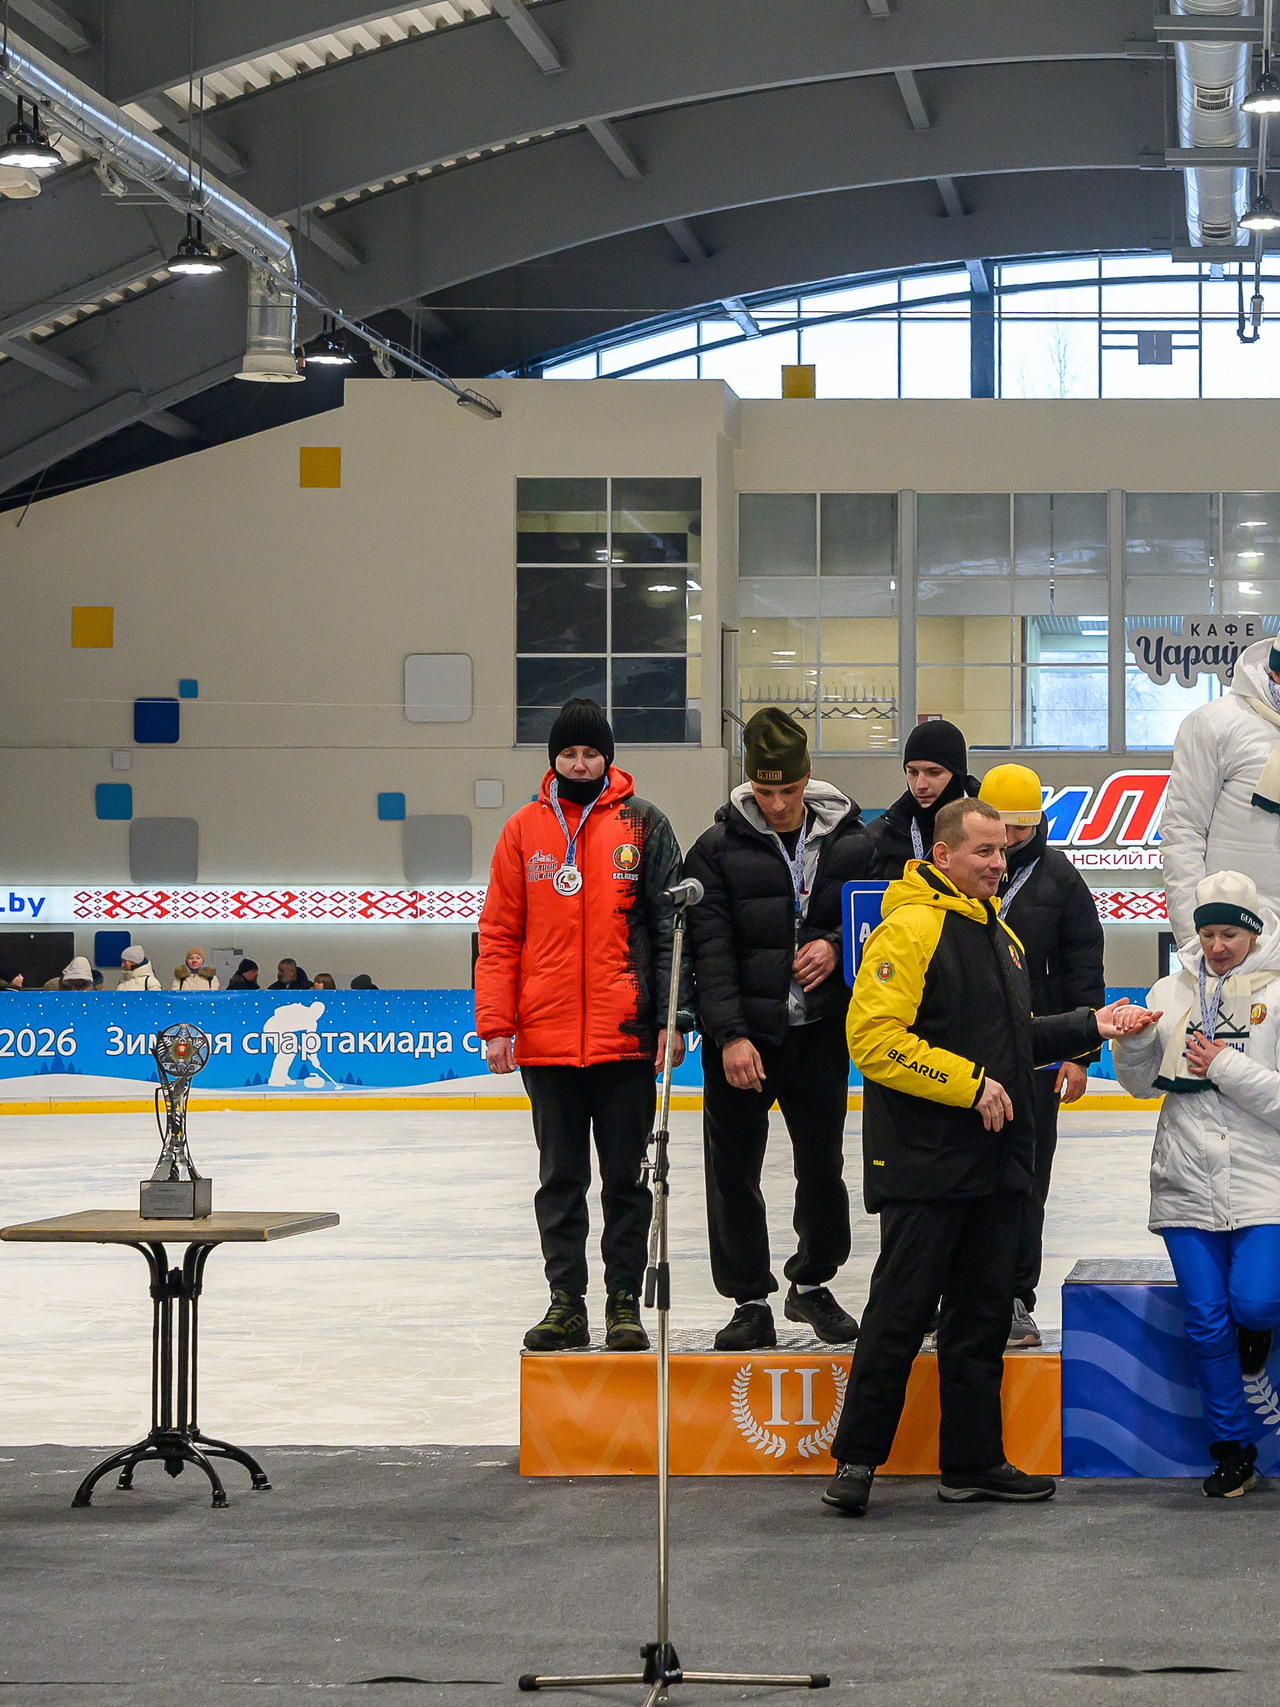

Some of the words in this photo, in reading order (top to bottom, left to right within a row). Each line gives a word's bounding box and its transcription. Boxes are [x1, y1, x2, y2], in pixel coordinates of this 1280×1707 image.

[1190, 623, 1255, 637] КАФЕ
[1136, 635, 1246, 680] Чараў
[1066, 850, 1143, 866] НСКИЙ
[0, 1027, 77, 1058] 2026
[242, 1031, 453, 1061] спартакиада
[886, 1048, 949, 1084] BELARUS
[763, 1368, 821, 1427] II
